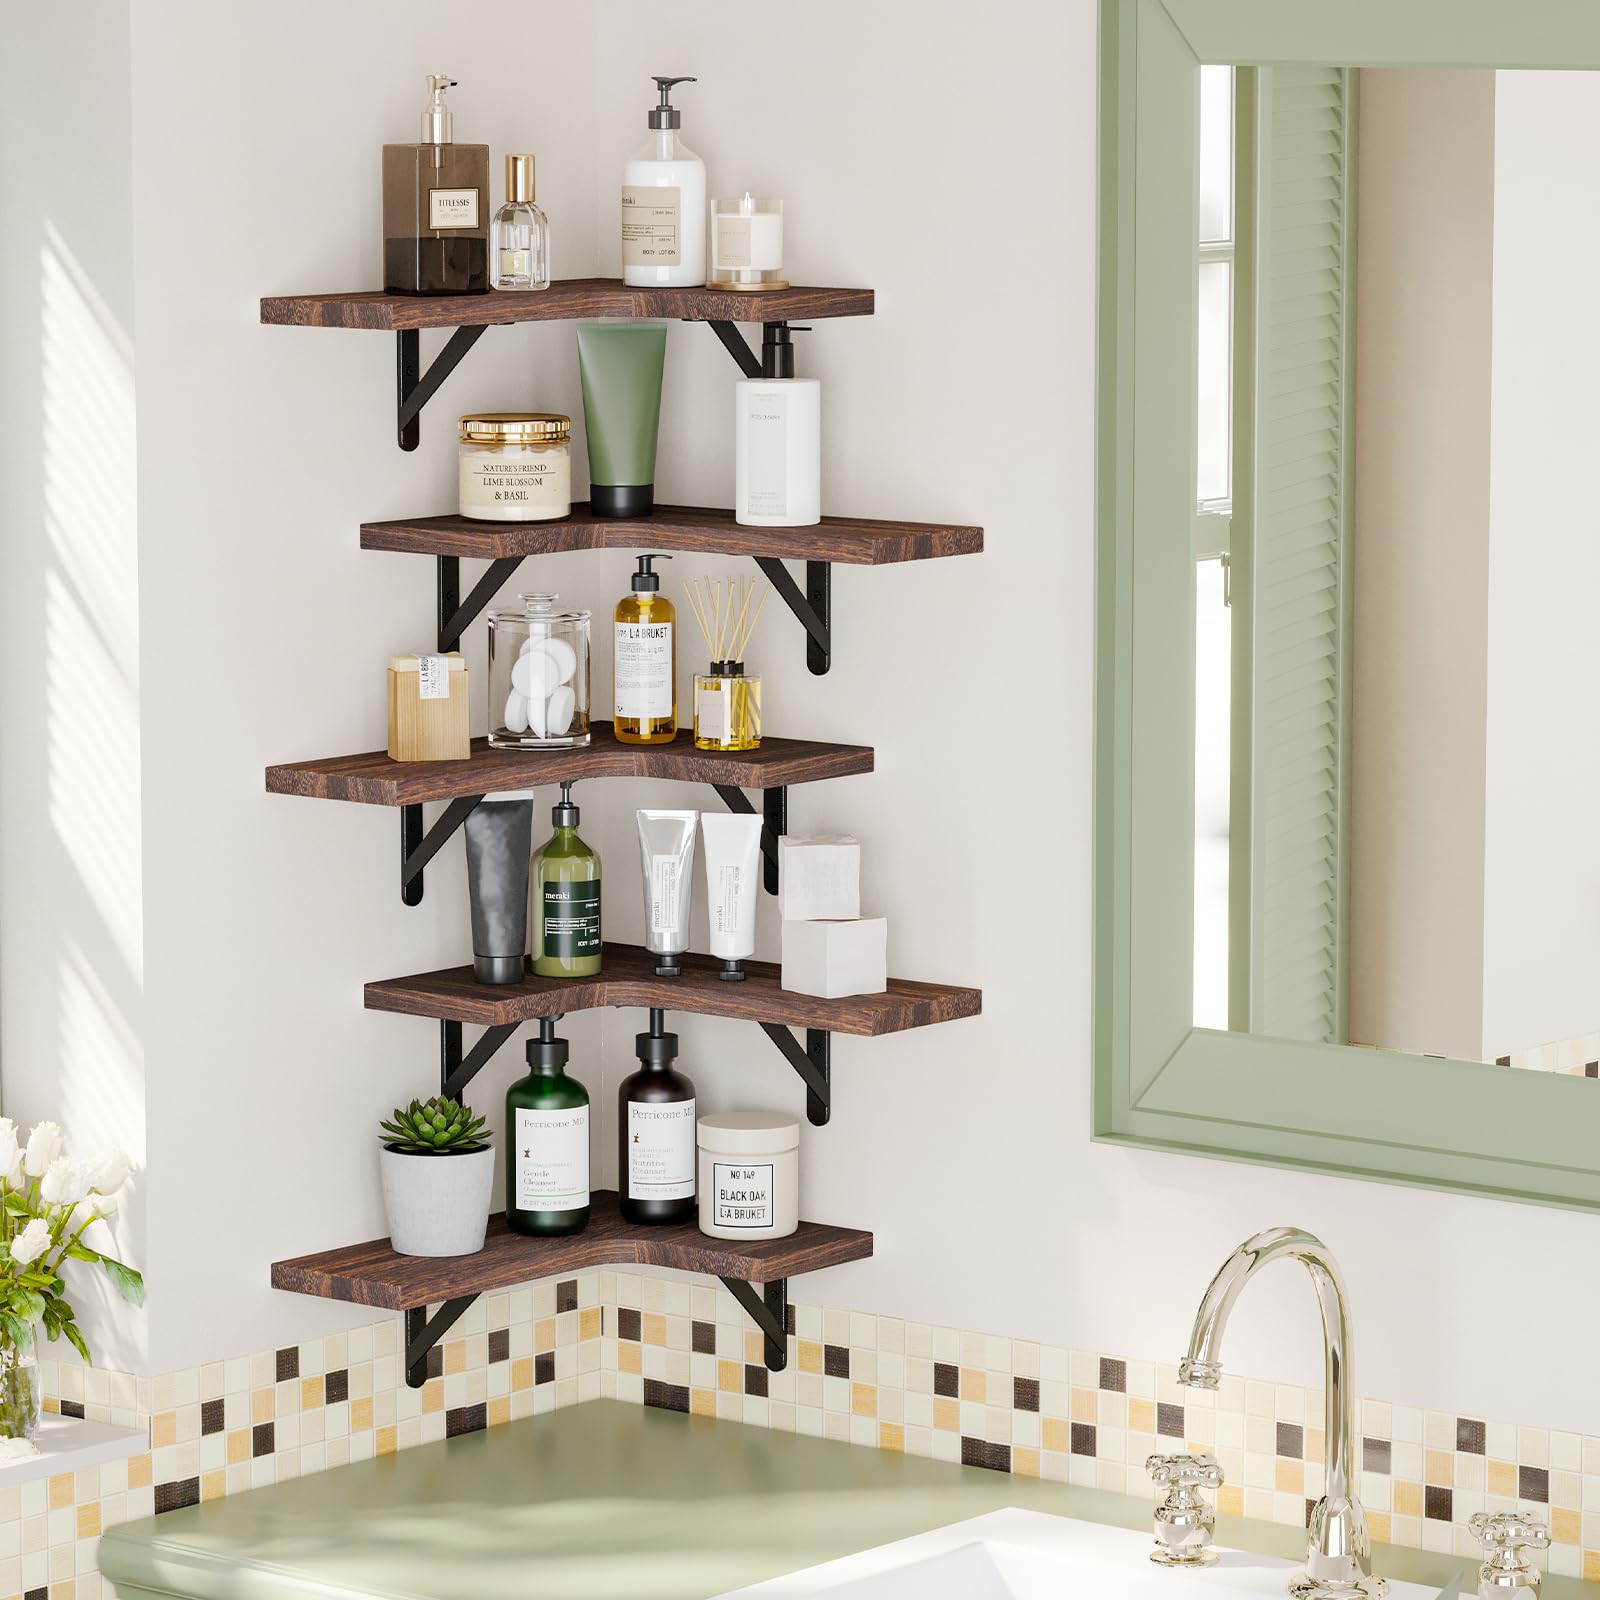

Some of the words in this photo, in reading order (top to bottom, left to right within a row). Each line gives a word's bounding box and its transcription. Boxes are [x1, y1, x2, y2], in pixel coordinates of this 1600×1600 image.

[438, 199, 470, 207] TITLESSIS
[519, 464, 547, 472] FRIEND
[483, 478, 504, 486] LIME
[505, 478, 543, 486] BLOSSOM
[494, 491, 502, 500] &
[504, 491, 529, 500] BASIL
[629, 628, 639, 639] L:A
[641, 627, 668, 639] BRUKET
[632, 1109, 681, 1119] Perricone
[524, 1119, 570, 1128] Perricone
[743, 1170, 755, 1180] 149
[720, 1189, 747, 1201] BLACK
[749, 1190, 767, 1201] OAK
[720, 1207, 732, 1219] L:A
[734, 1208, 766, 1219] BRUKET
